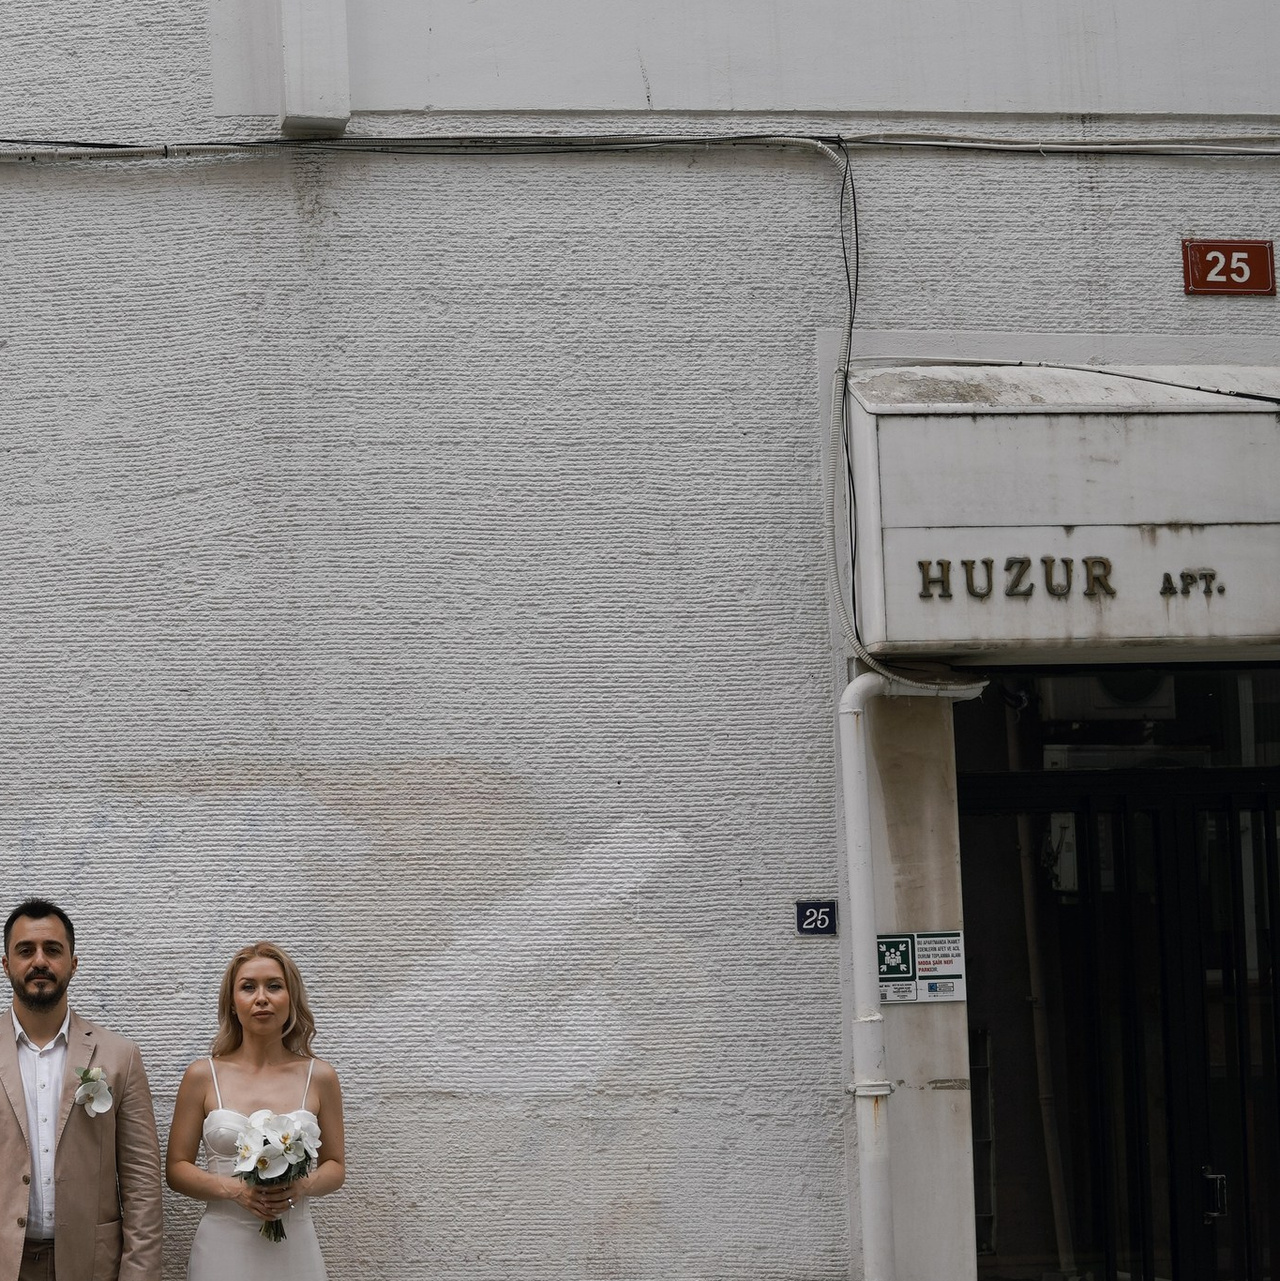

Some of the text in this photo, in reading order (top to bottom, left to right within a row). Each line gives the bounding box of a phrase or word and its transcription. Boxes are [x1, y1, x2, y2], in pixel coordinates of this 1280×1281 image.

[1205, 251, 1251, 284] 25
[917, 556, 1226, 599] HUZUR APT.
[802, 908, 830, 929] 25
